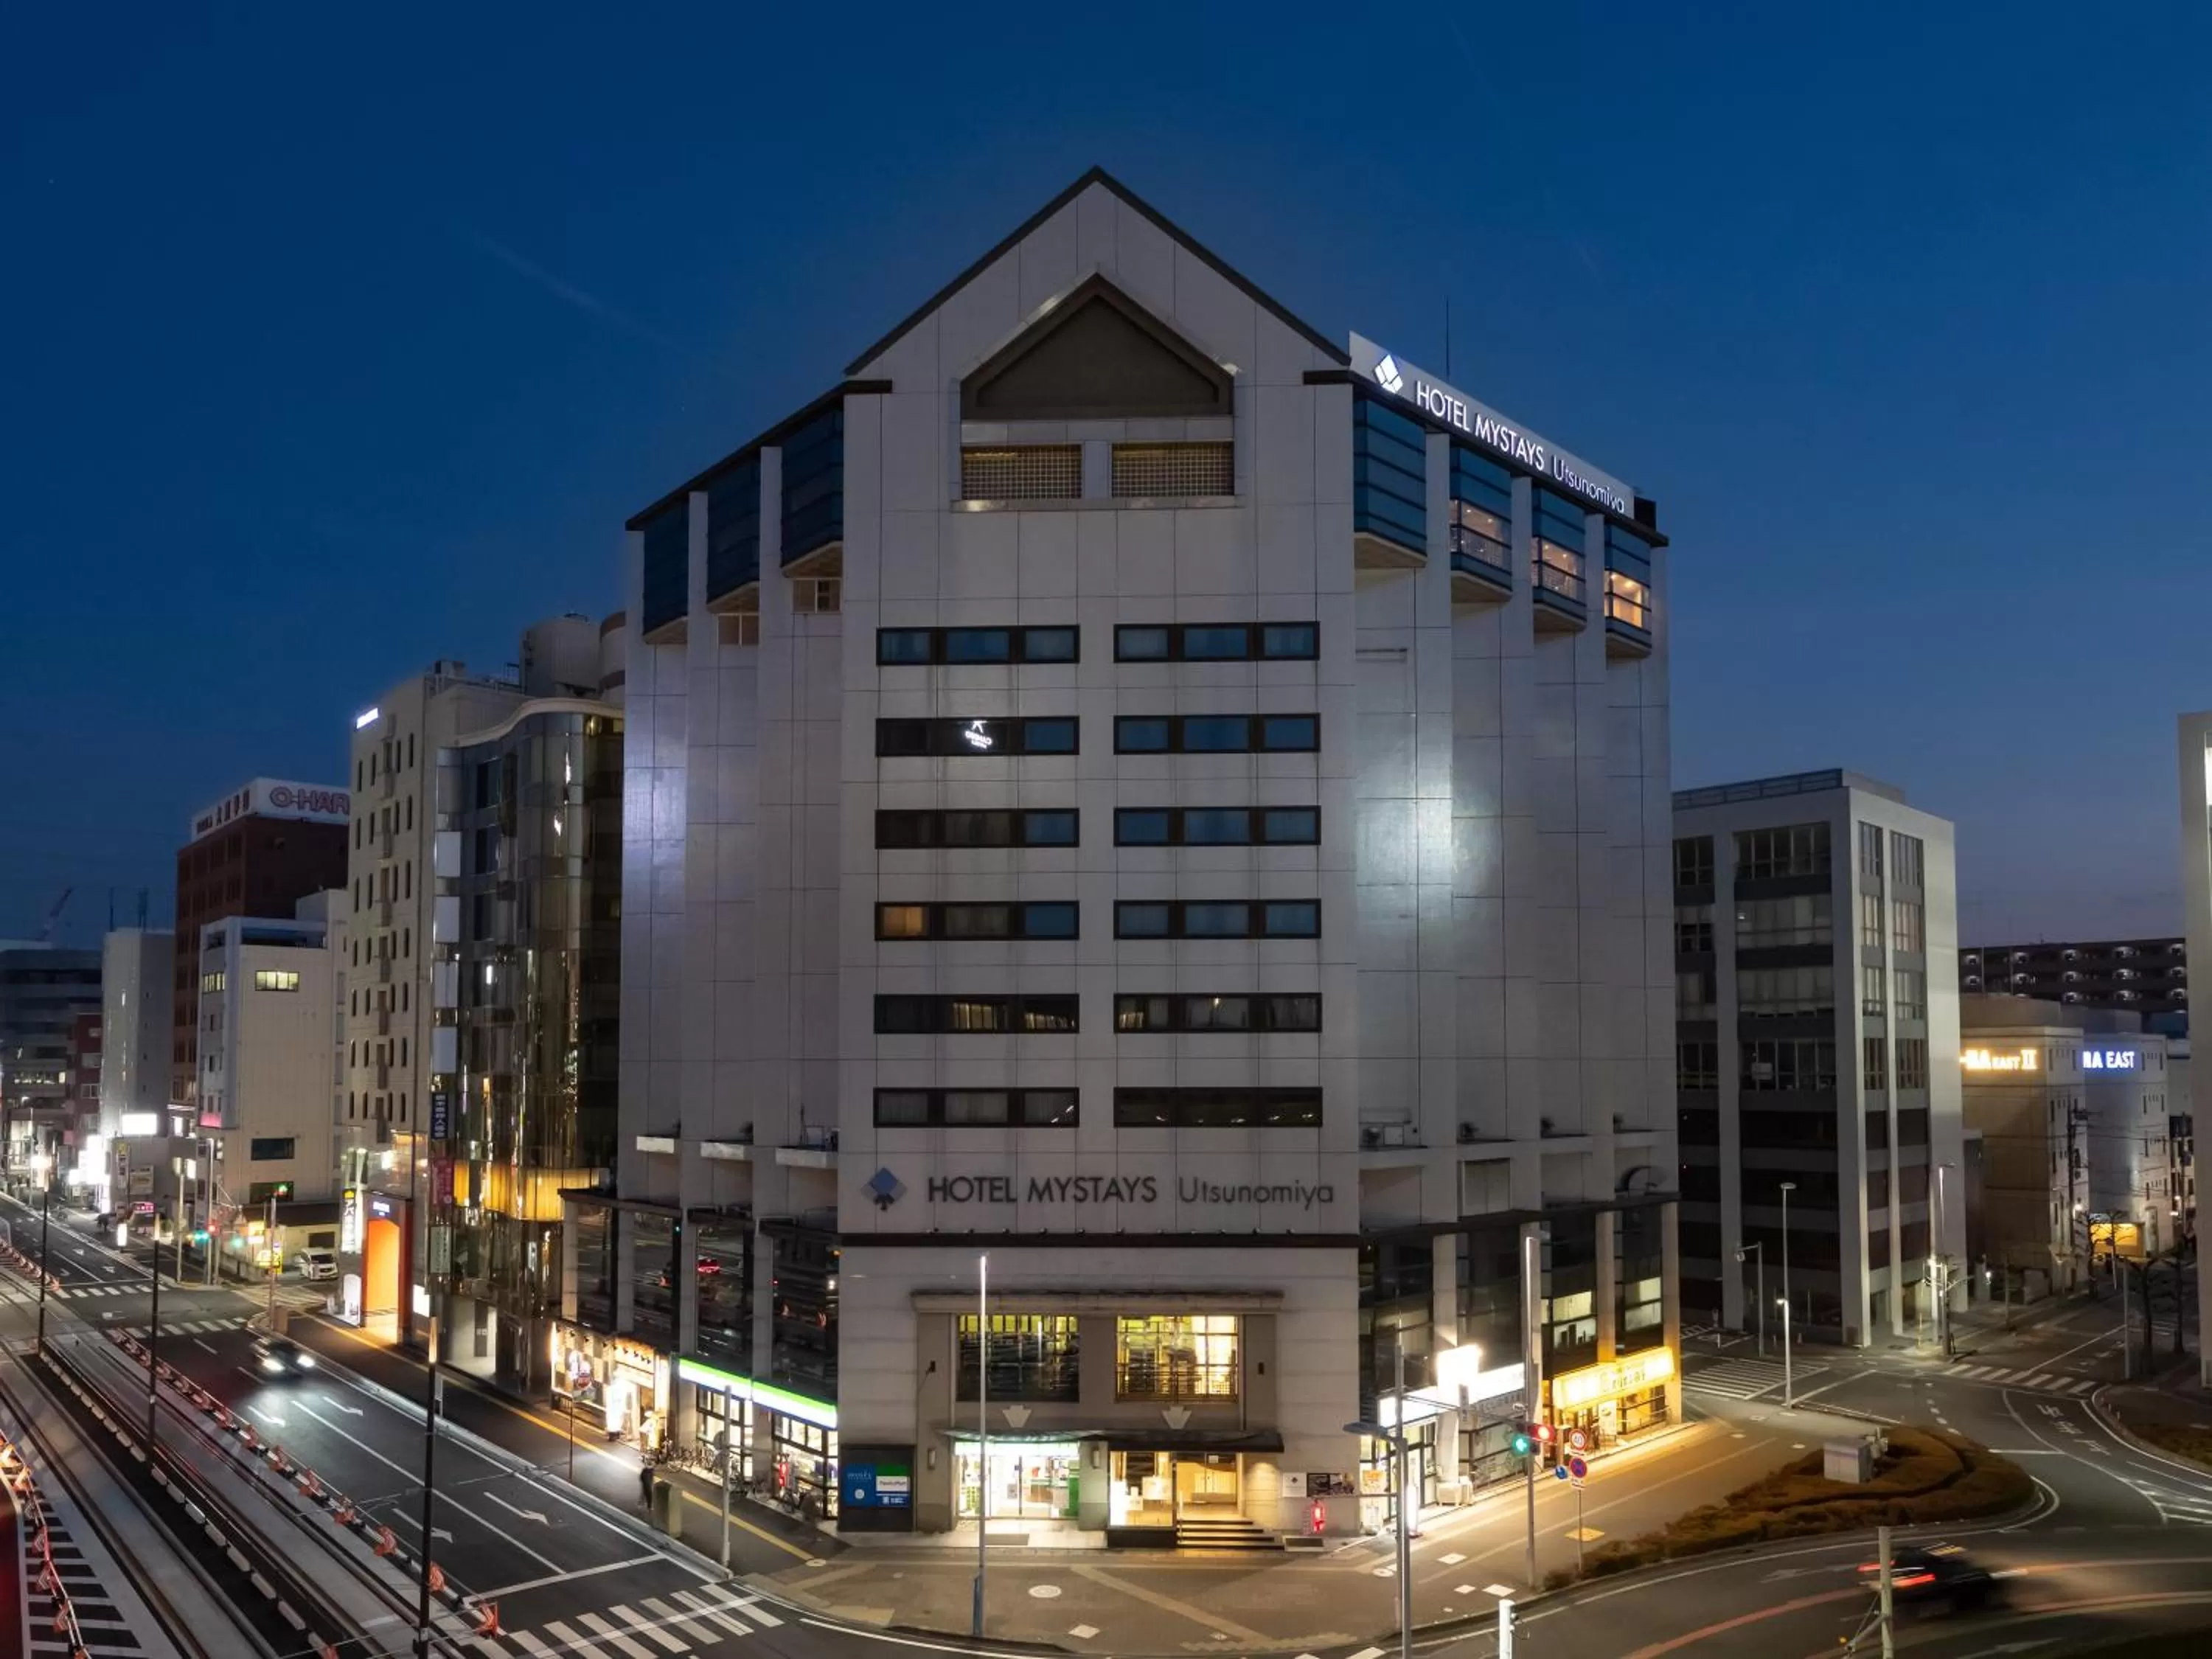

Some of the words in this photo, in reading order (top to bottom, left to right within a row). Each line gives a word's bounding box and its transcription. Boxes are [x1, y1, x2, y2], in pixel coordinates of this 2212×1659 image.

[1416, 380, 1471, 432] HOTEL
[1474, 414, 1545, 471] MYSTAYS
[1551, 453, 1625, 514] Utsunomiya
[2105, 1050, 2135, 1069] EAST
[927, 1176, 1018, 1204] HOTEL
[1026, 1176, 1158, 1204] MYSTAYS
[1178, 1175, 1335, 1210] Utsunomiya
